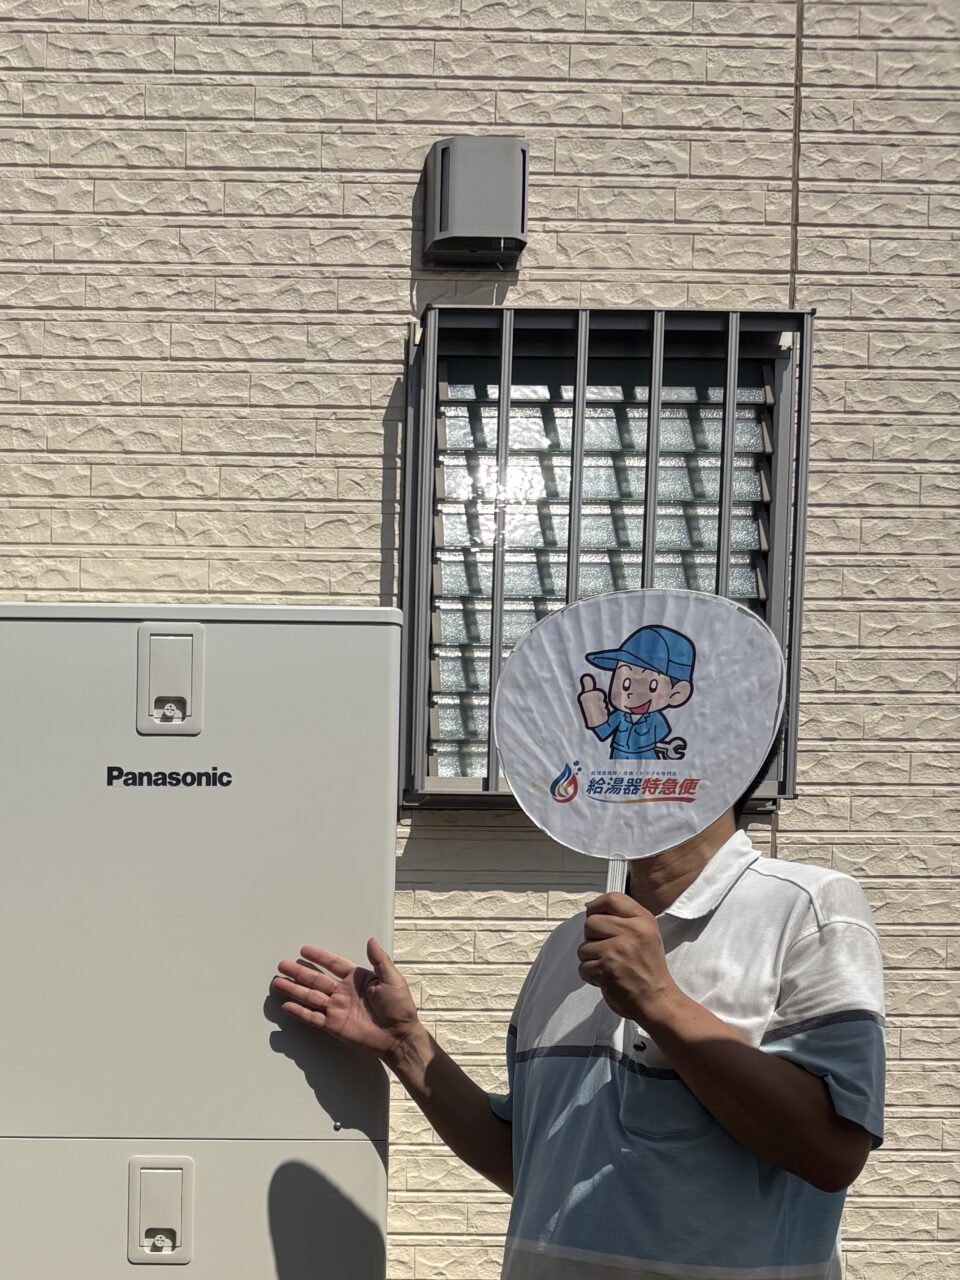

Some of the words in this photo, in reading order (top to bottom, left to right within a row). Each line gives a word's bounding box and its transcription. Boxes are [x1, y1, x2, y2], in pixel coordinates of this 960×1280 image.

[107, 766, 232, 787] Panasonic
[586, 777, 701, 796] 給湯器特急便
